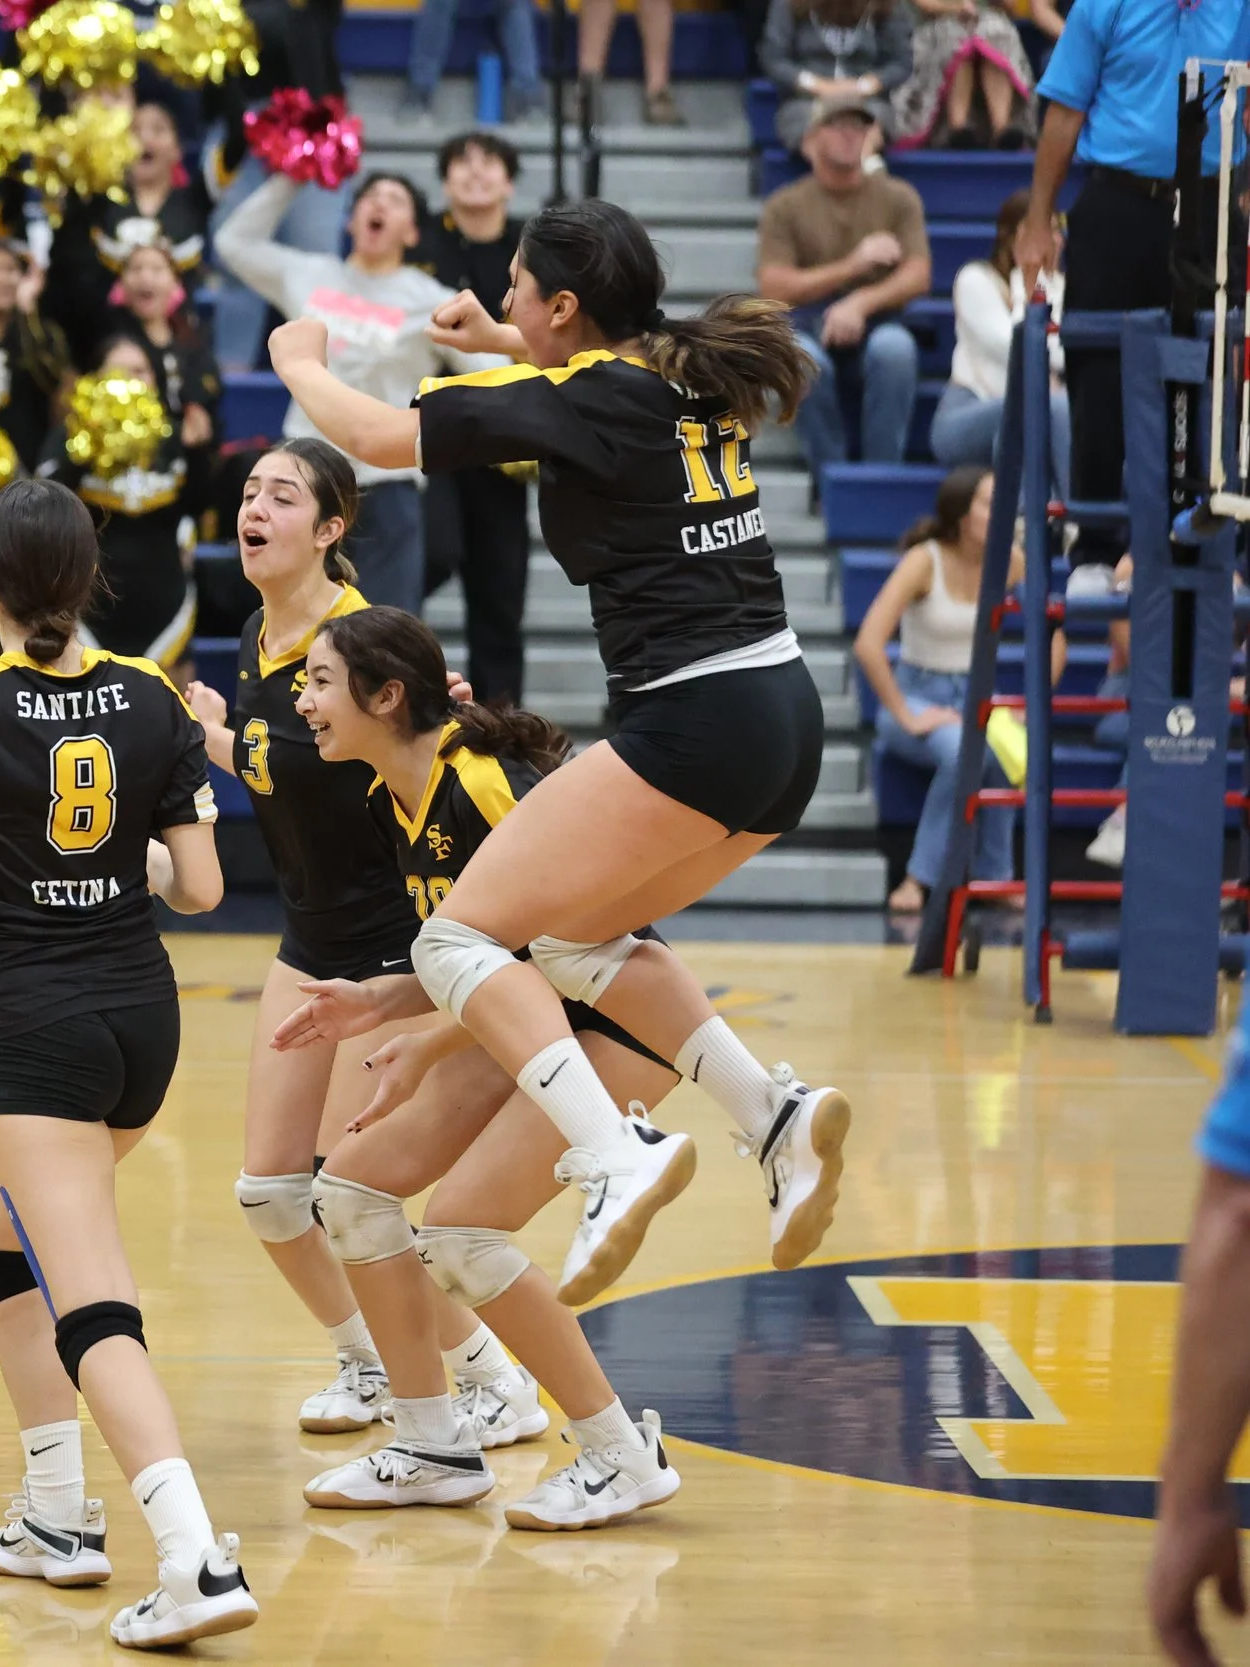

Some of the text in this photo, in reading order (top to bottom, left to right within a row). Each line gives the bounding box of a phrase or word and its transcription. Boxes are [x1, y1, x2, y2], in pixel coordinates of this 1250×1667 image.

[675, 410, 756, 504] 12
[96, 683, 130, 714] FE
[241, 717, 275, 796] 3
[46, 733, 117, 855] 8
[426, 823, 454, 861] SF
[31, 876, 121, 906] CETINA
